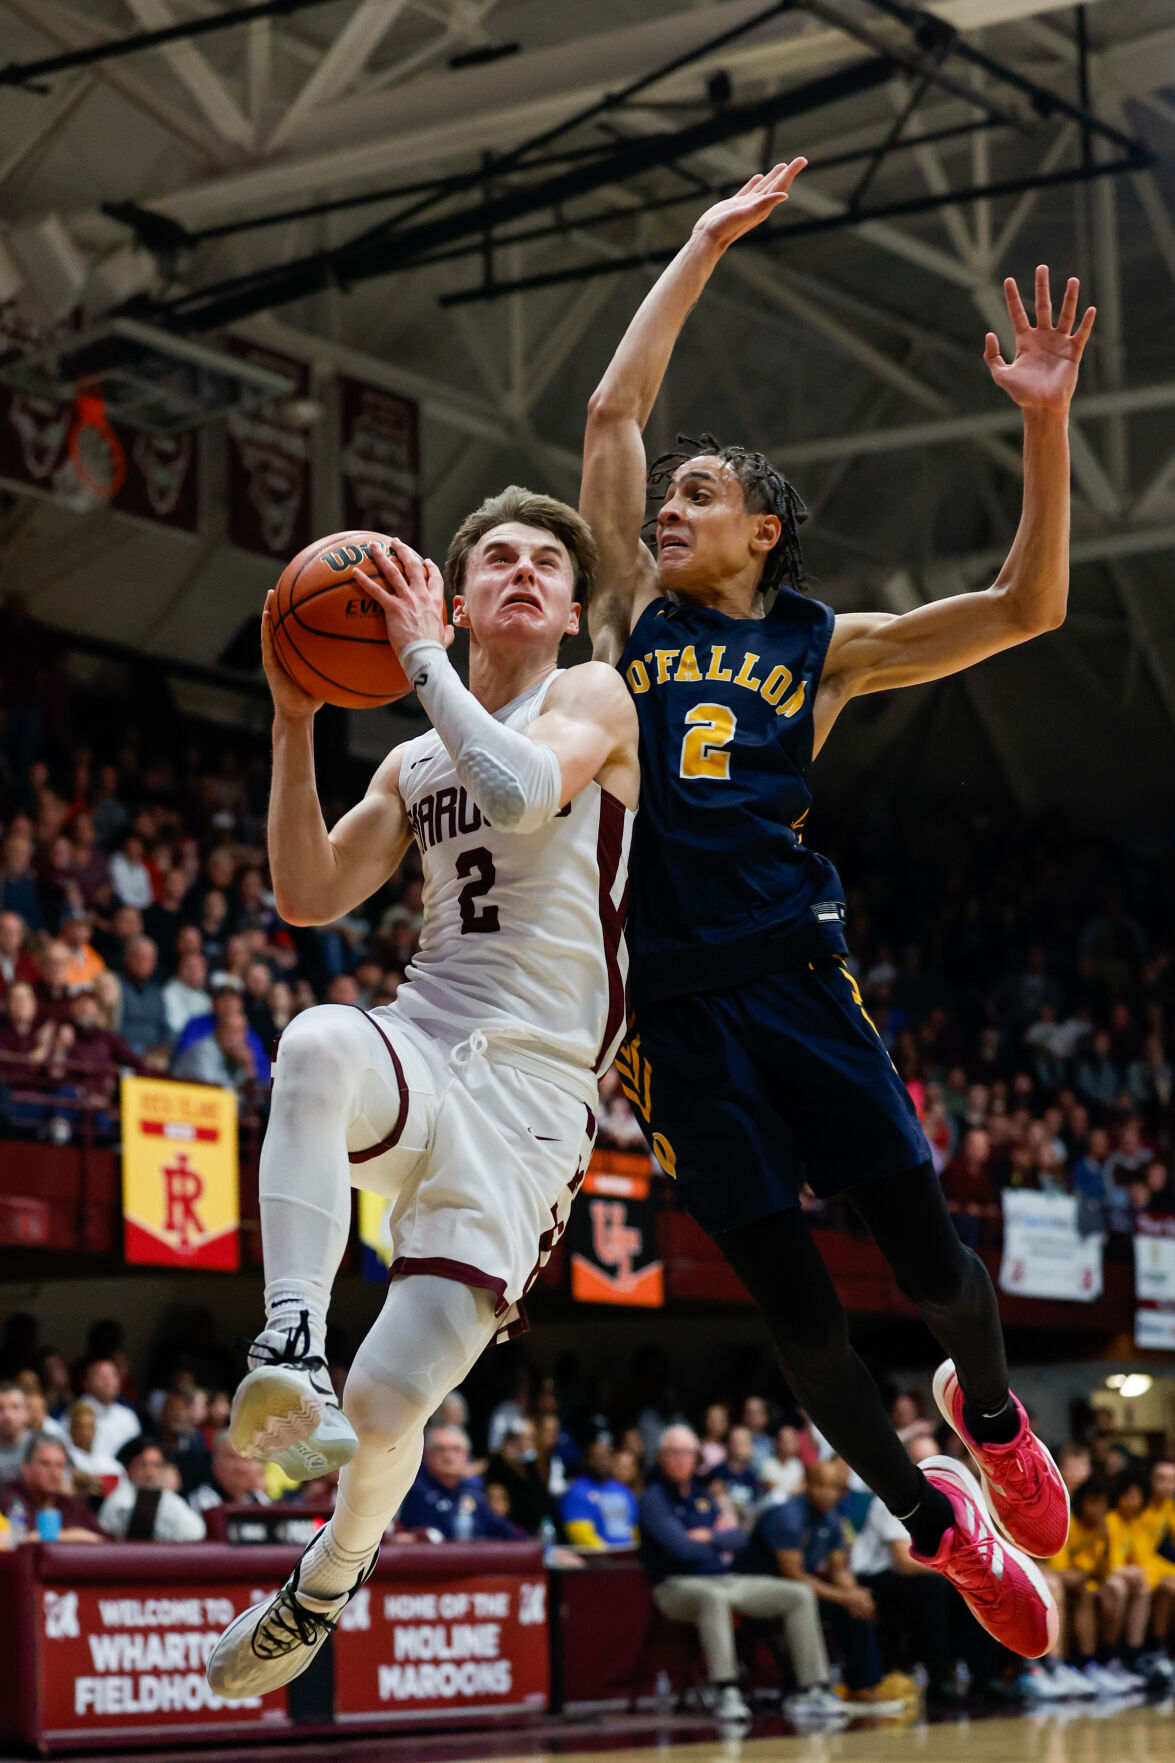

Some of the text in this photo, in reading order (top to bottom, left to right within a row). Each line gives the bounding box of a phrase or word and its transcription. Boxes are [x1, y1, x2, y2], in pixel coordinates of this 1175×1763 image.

[345, 599, 385, 615] EV
[679, 702, 737, 780] 2
[455, 846, 500, 935] 2
[99, 1597, 235, 1627] WELCOME TO
[384, 1591, 510, 1620] HOME OF THE
[393, 1623, 502, 1661] MOLINE
[75, 1673, 262, 1715] FIELDHO
[378, 1659, 512, 1701] MAROONS
